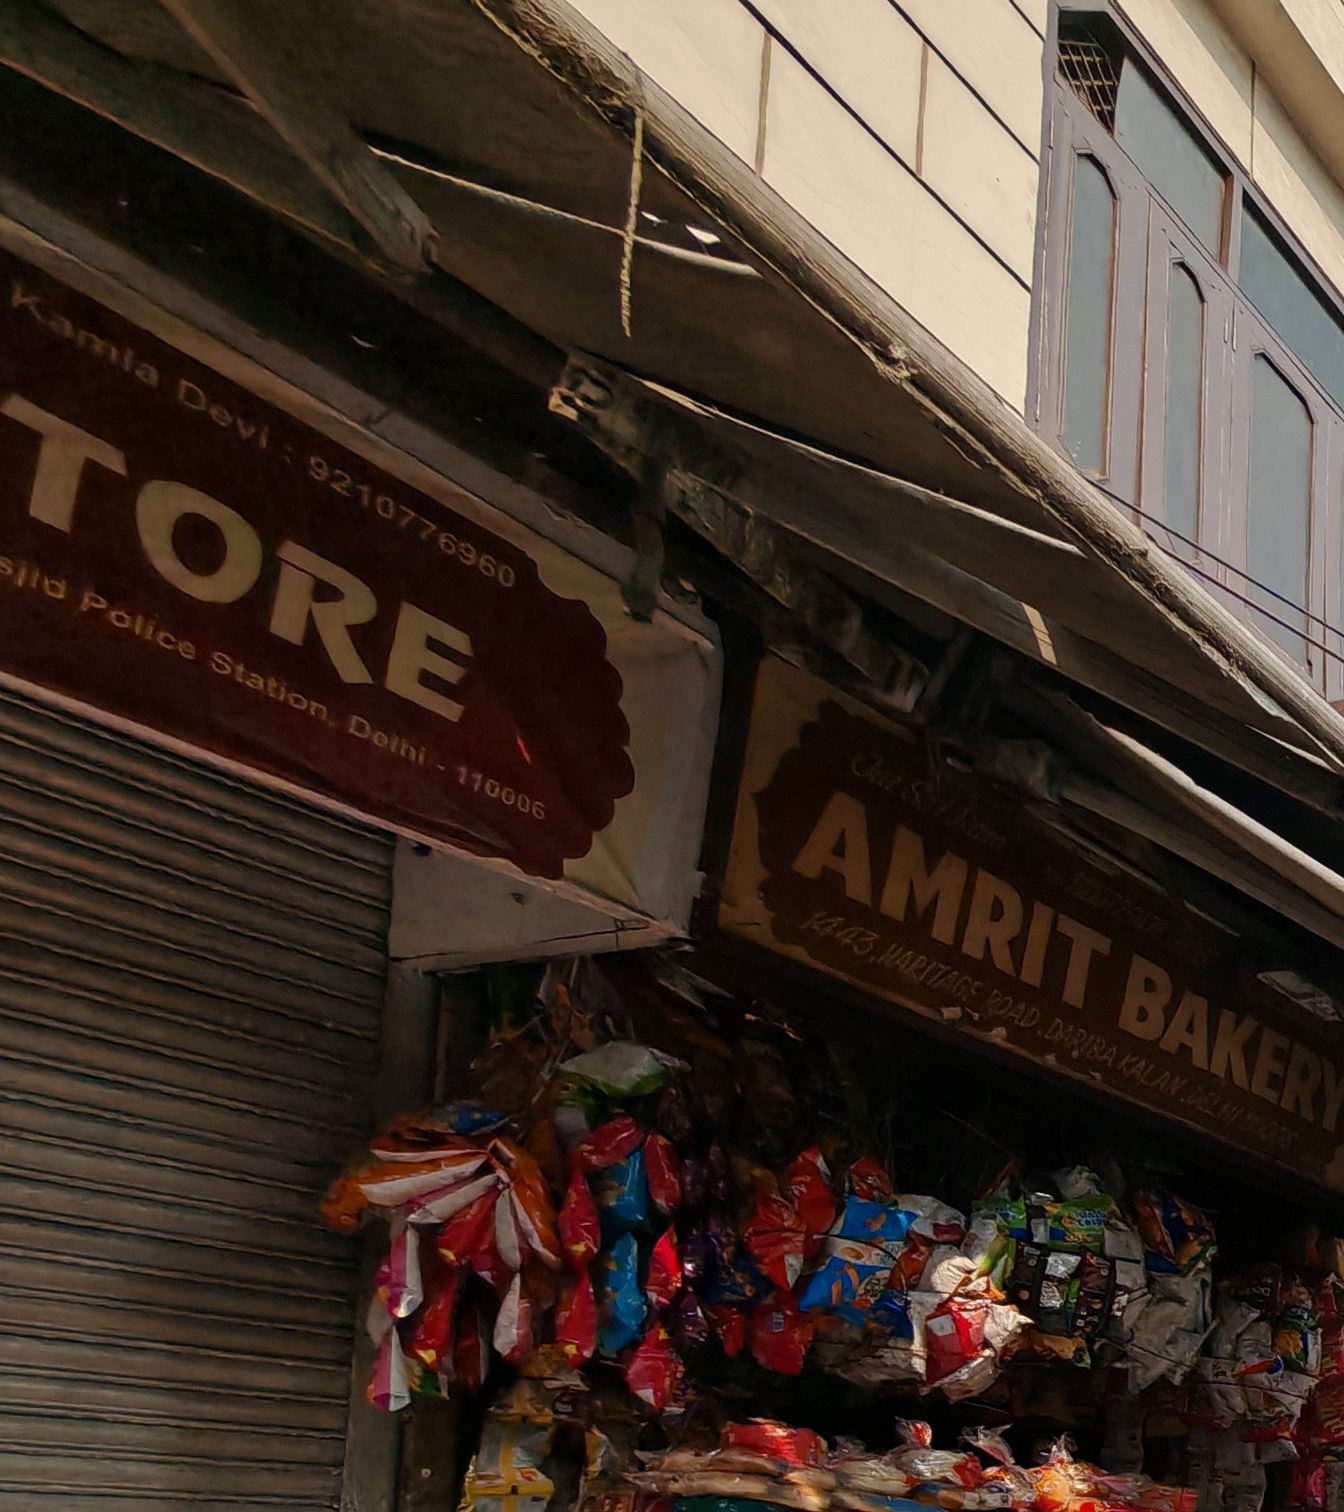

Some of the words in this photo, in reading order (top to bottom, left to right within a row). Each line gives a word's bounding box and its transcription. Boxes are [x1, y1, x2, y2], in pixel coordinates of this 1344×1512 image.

[12, 283, 160, 387] Kamla
[178, 379, 270, 448] Devi
[308, 455, 517, 588] 9210776960
[80, 591, 197, 660] Police
[348, 713, 427, 767] Delhi
[457, 764, 547, 820] 110006
[791, 789, 1112, 1010] AMRIT
